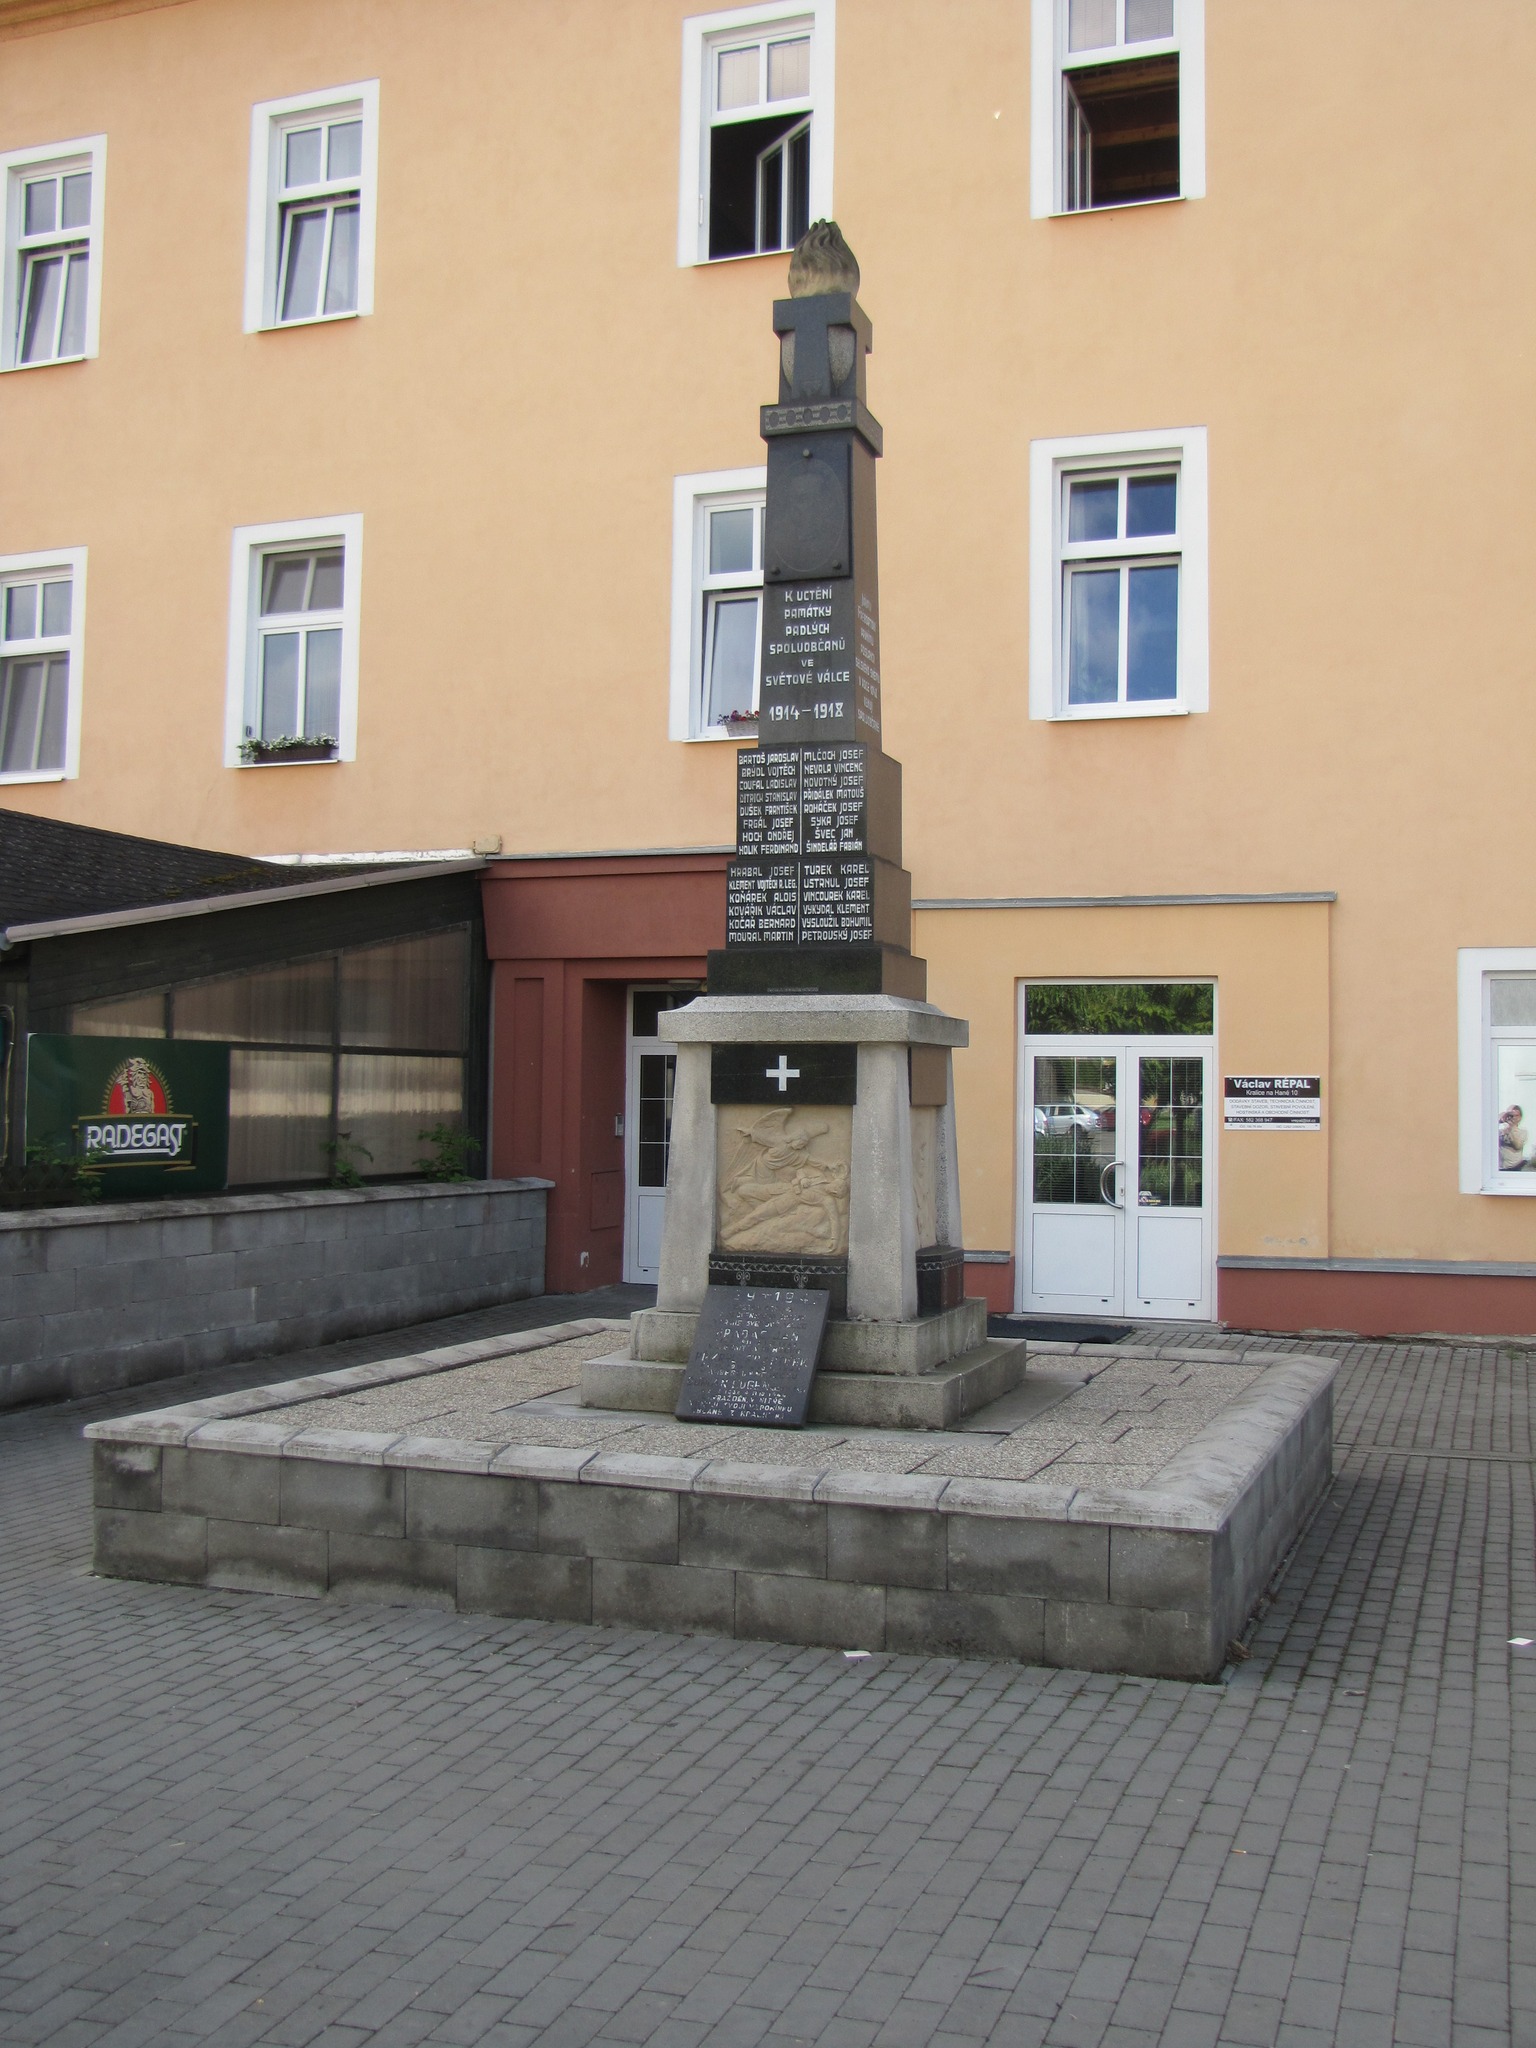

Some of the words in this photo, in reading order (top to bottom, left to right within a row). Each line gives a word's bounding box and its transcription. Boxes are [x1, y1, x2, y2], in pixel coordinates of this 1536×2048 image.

[785, 591, 793, 602] K
[796, 585, 832, 601] UCTĚNÍ
[784, 604, 832, 619] PAMÁTKY
[785, 622, 830, 636] PADLÝCH
[769, 637, 846, 655] SPOLUOBČANŮ
[801, 659, 814, 667] VE
[765, 671, 813, 686] SVĚTOVÉ
[817, 669, 850, 683] VÁLCE
[739, 752, 765, 765] BARTOŠ
[767, 752, 799, 765] JAROSLAV
[839, 750, 864, 761] JOSEF
[768, 764, 795, 778] VOJTĚCH
[804, 763, 831, 774] NEVRLA
[833, 762, 863, 773] VINCENC
[739, 780, 764, 790] COUFAL
[766, 778, 797, 789] LADISLAV
[804, 773, 837, 787] NOVOTNÝ
[840, 775, 864, 788] JOSEF
[765, 791, 797, 802] STANISLAV
[836, 786, 864, 799] MATOUŠ
[740, 803, 762, 816] DUŠEK
[765, 802, 798, 816] FRANTIŠEK
[804, 800, 837, 813] ROHÁČEK
[839, 801, 863, 815] JOSEF
[772, 817, 794, 830] JOSEF
[810, 816, 831, 827] SYKA
[836, 815, 859, 828] JOSEF
[742, 831, 762, 842] HOCH
[767, 828, 795, 843] ONDŘEJ
[815, 827, 836, 839] ŠVEC
[840, 828, 854, 841] JAN
[761, 843, 799, 855] FERDINAND
[839, 838, 863, 851] FABIÁN
[731, 867, 762, 877] HRABAL
[769, 866, 795, 879] JOSEF
[804, 865, 832, 875] TUREK
[840, 864, 869, 874] KAREL
[729, 880, 755, 890] KLEMENT
[803, 878, 840, 888] USTRNUL
[844, 877, 869, 889] JOSEF
[774, 892, 797, 902] ALOIS
[803, 891, 844, 901] VINCOUREK
[846, 890, 870, 901] KAREL
[729, 903, 763, 916] KOVÁŘIK
[766, 903, 796, 915] VÁCLAV
[836, 904, 870, 914] KLEMENT
[759, 918, 796, 929] BERNARD
[801, 915, 839, 928] VYSLOUŽIL
[841, 917, 872, 927] BOHUMIL
[729, 932, 761, 942] MOURAL
[763, 931, 794, 941] MARTIN
[849, 930, 872, 942] JOSEF
[1234, 1079, 1271, 1088] Václav
[87, 1123, 186, 1156] RADEGAST
